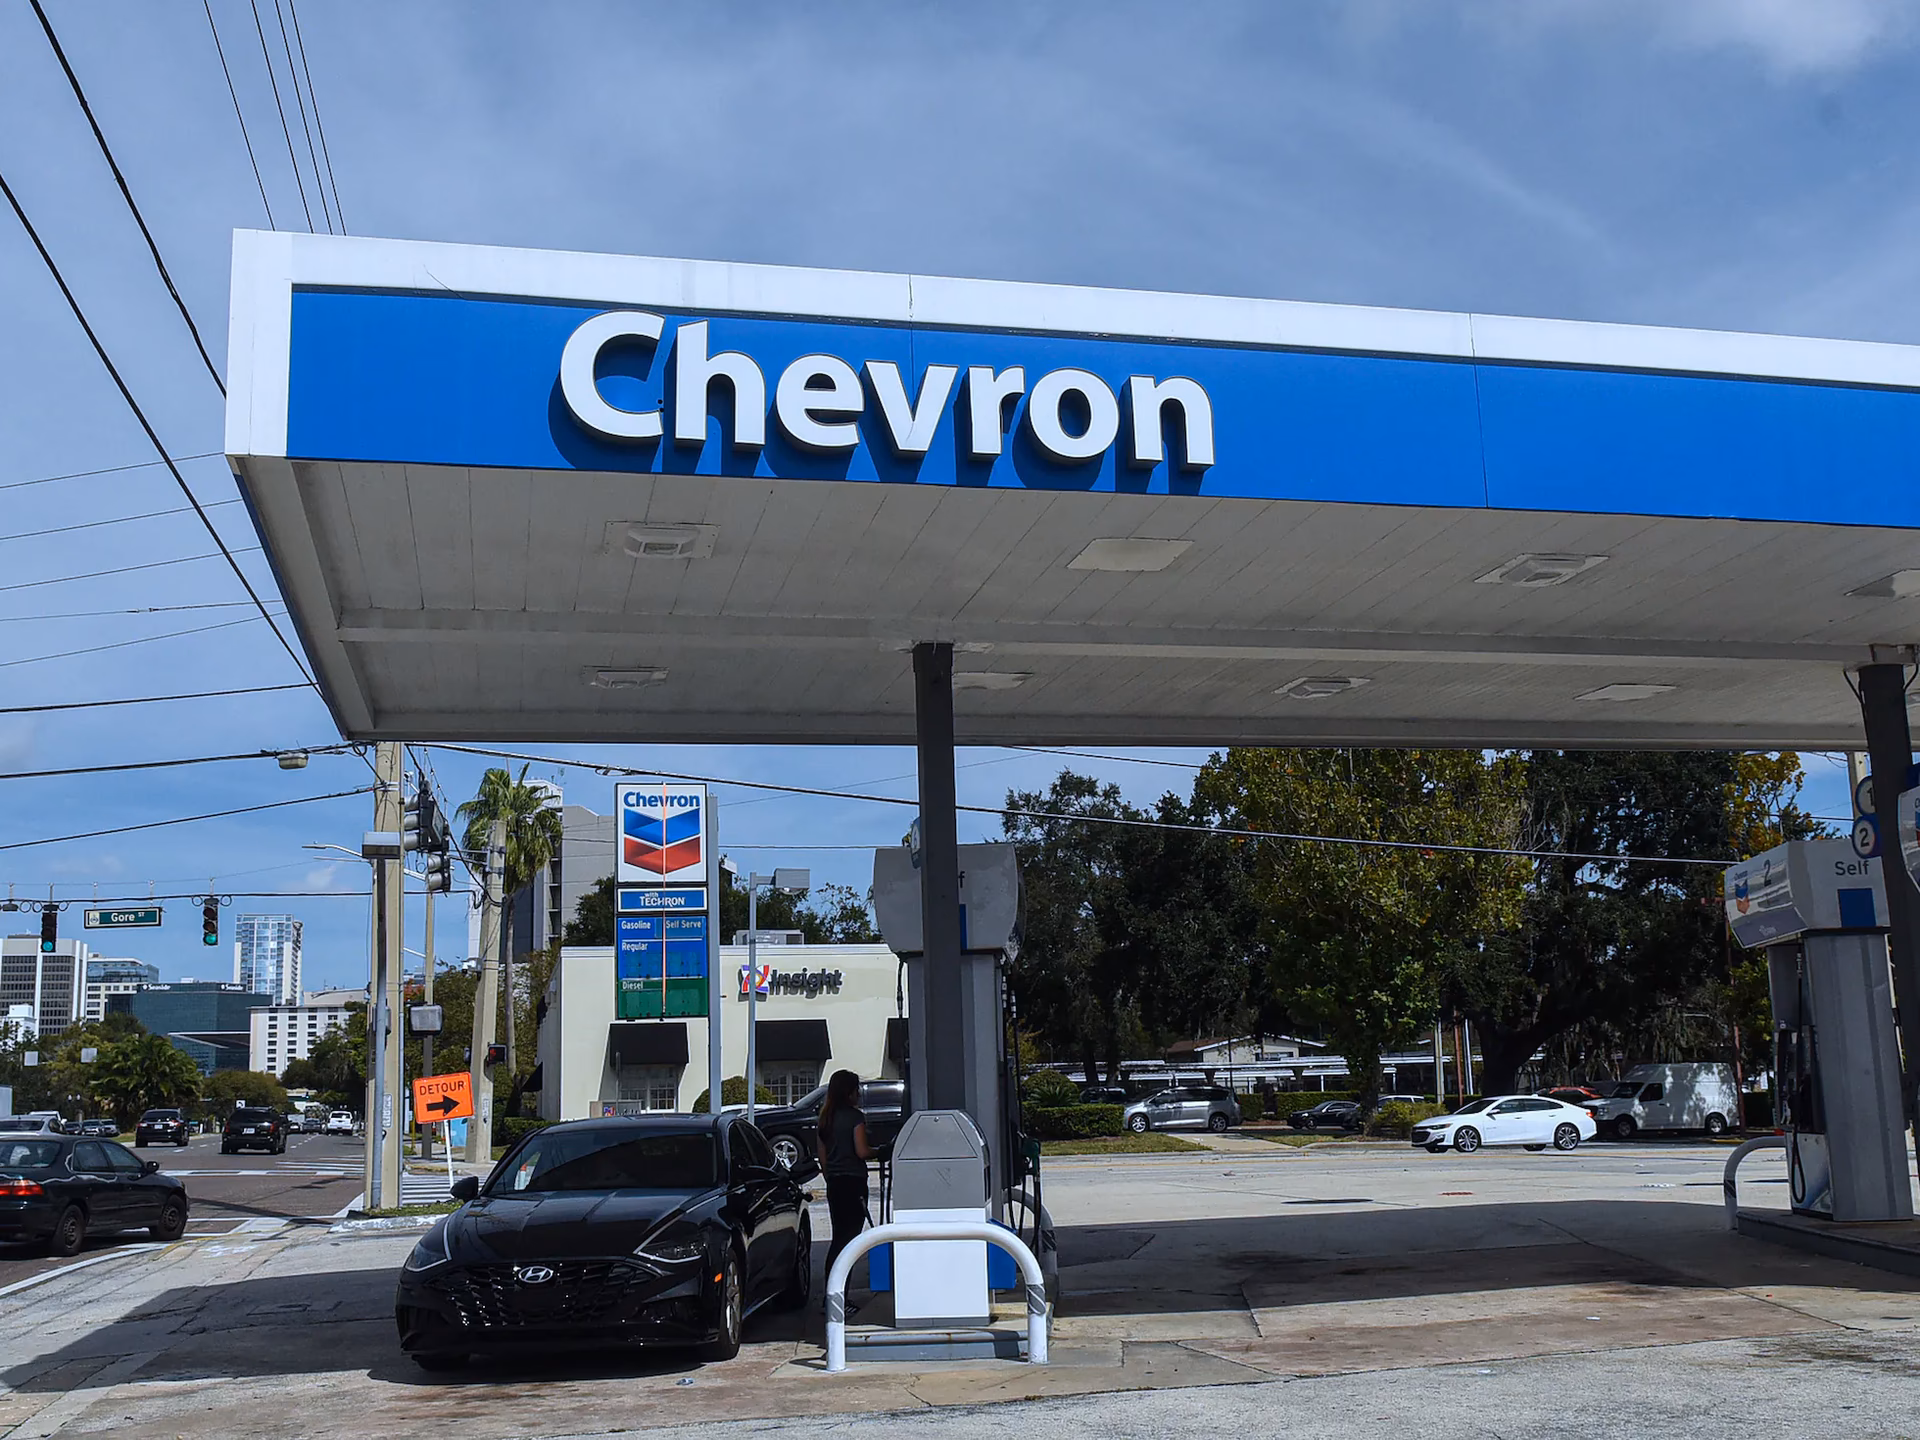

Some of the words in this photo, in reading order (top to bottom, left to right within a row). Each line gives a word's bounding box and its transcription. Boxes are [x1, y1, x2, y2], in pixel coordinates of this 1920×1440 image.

[559, 309, 1215, 469] Chevron
[623, 791, 700, 807] Chevron
[1859, 828, 1870, 847] 2
[1763, 859, 1772, 888] 2
[1835, 860, 1870, 876] Self
[639, 896, 686, 907] TECHRON
[111, 912, 135, 923] Gore
[621, 921, 651, 930] Gasoline
[666, 920, 680, 929] Self
[681, 920, 702, 929] Serve
[621, 942, 648, 953] Regular
[622, 981, 644, 990] Diesel
[772, 967, 842, 992] Insight
[419, 1080, 465, 1096] DETOUR
